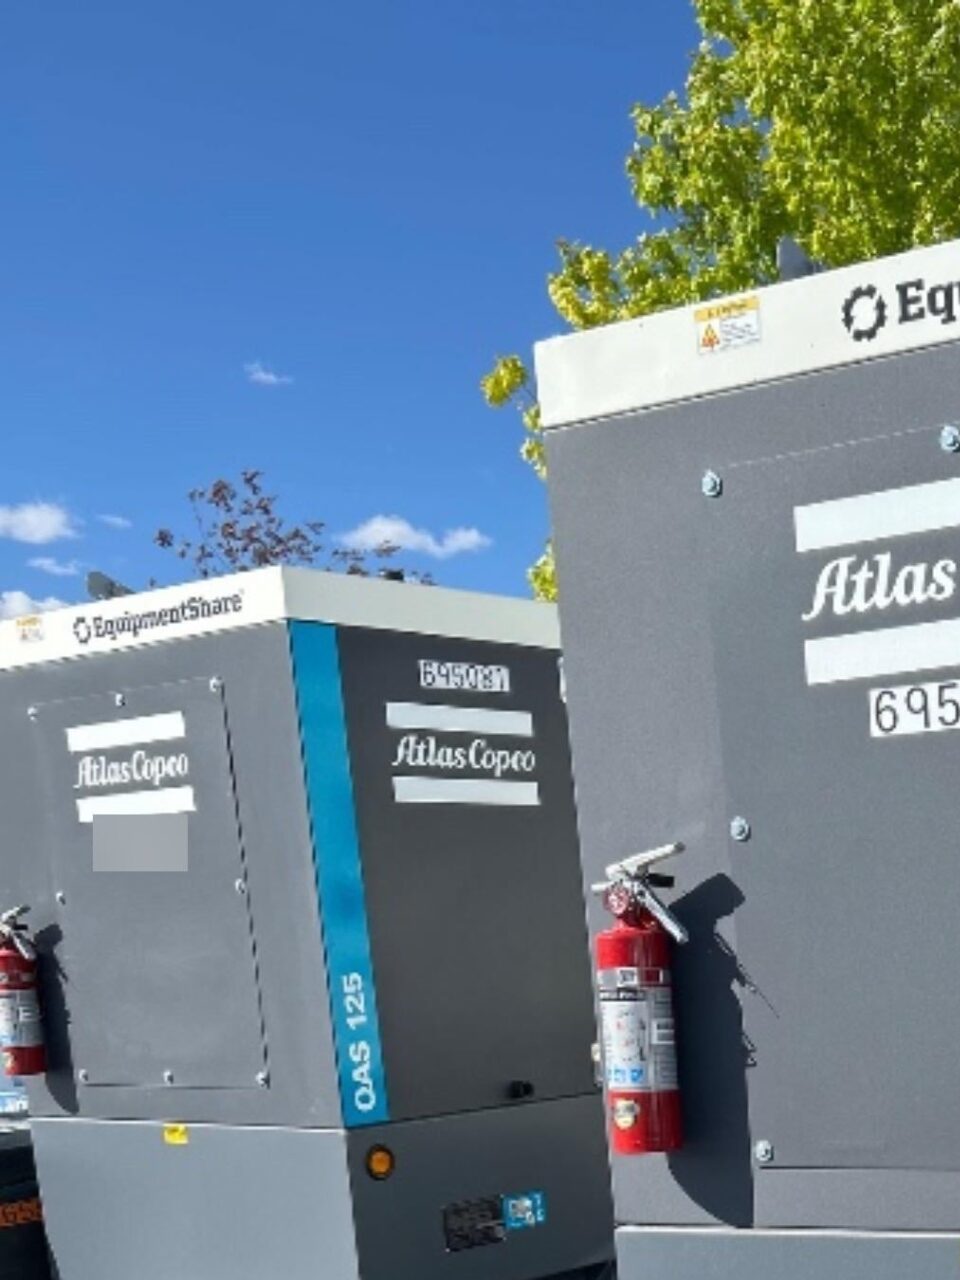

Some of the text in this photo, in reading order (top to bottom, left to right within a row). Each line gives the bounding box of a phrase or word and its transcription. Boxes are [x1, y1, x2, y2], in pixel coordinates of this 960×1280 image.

[801, 552, 957, 621] Atlas
[93, 594, 243, 640] EquipmentShare
[422, 662, 504, 690] 695081
[73, 750, 188, 788] Atlas Copco
[391, 734, 536, 778] Atlas Copco
[343, 972, 368, 1030] 125
